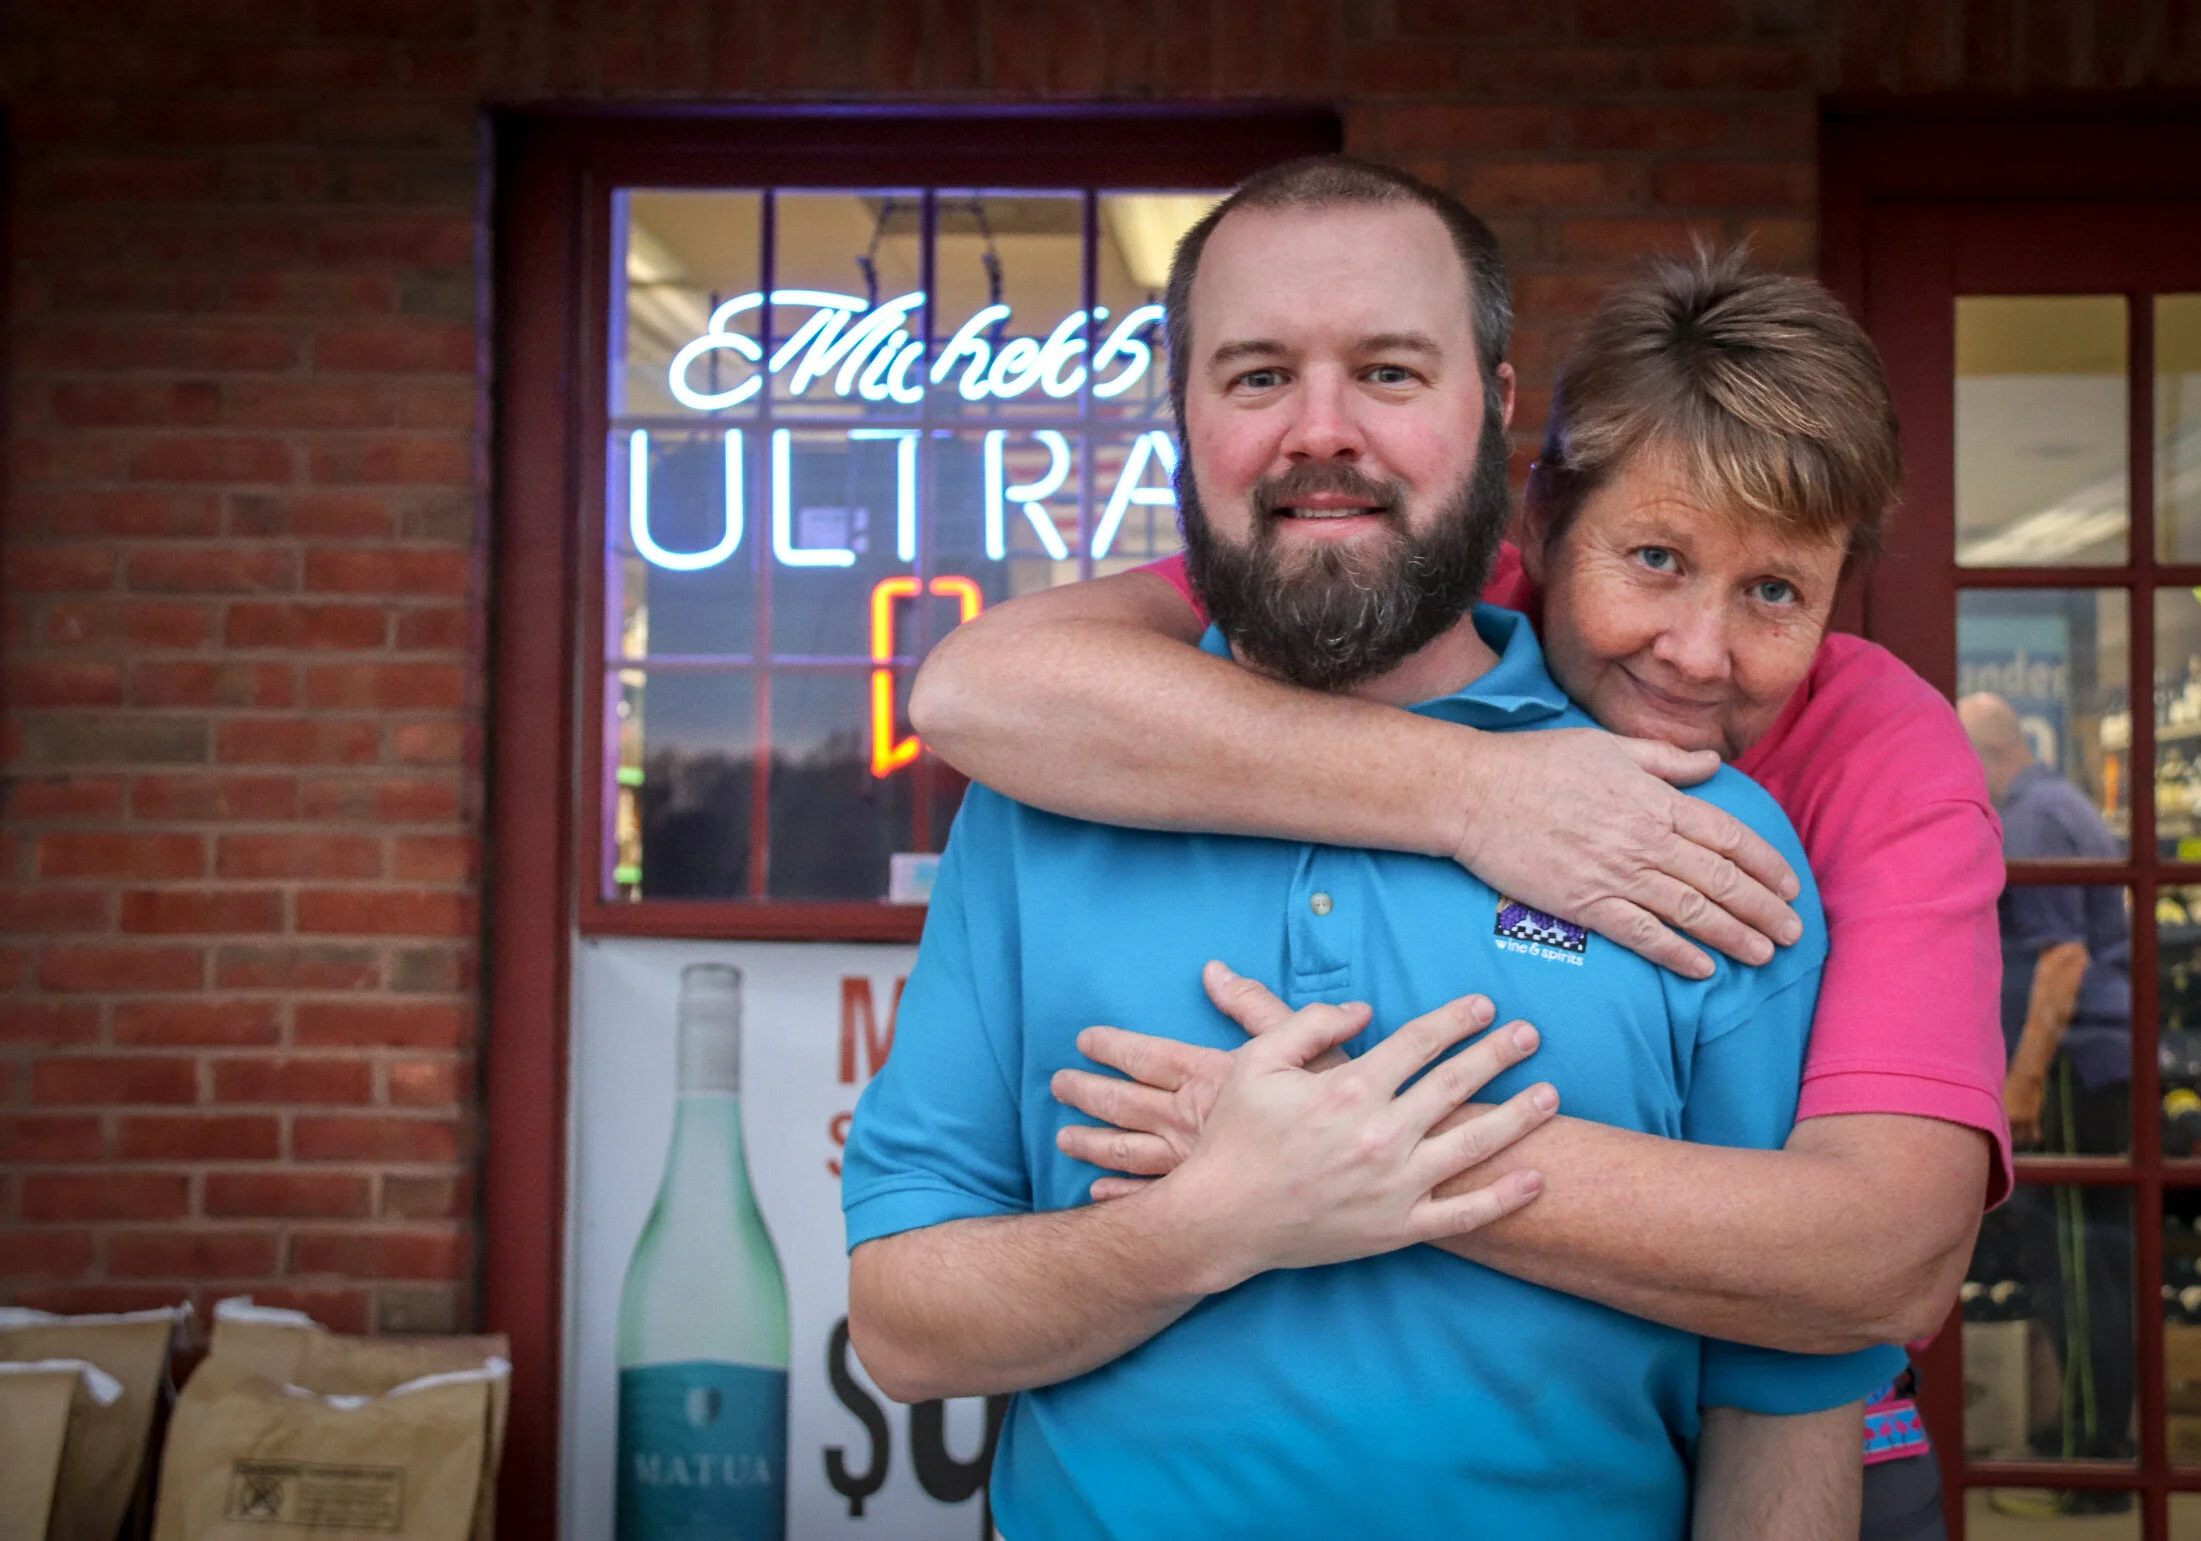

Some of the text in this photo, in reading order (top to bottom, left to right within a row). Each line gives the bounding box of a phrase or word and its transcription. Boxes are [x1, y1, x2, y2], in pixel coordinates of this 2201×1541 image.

[630, 428, 1178, 571] ULTRA
[1495, 938, 1527, 953] wine
[1540, 948, 1584, 966] spirits
[633, 1452, 772, 1487] MATUA
